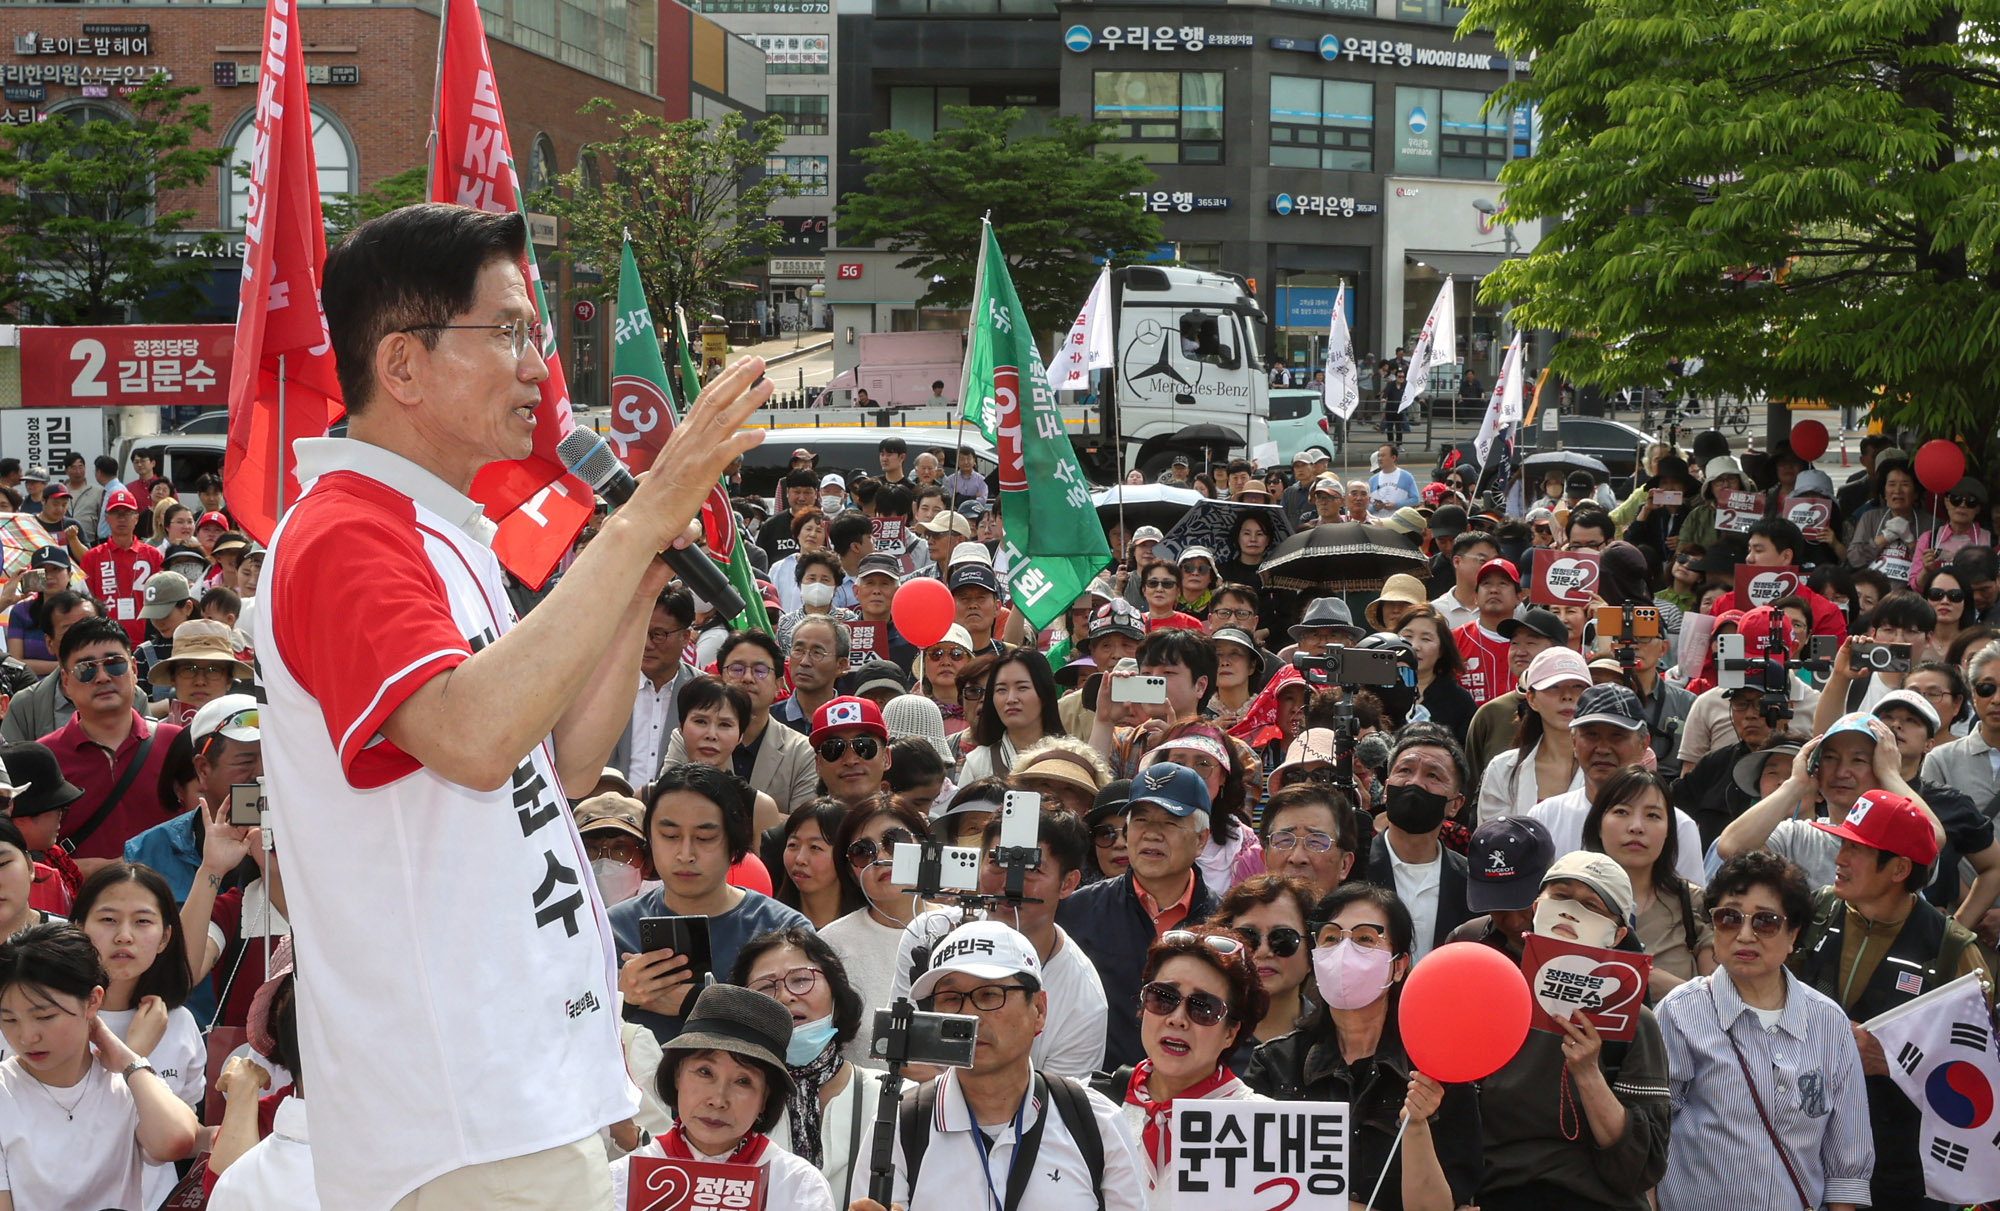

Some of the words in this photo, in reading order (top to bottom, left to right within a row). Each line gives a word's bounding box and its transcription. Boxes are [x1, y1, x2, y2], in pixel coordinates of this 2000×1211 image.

[40, 36, 148, 56] 로이드밤헤어
[1099, 26, 1204, 51] 우리은행
[1208, 34, 1253, 46] 운정중앙지점
[1342, 37, 1413, 67] 우리은행
[1416, 48, 1456, 67] WOORI
[1456, 53, 1492, 70] BANK
[29, 88, 42, 98] 4F
[1197, 197, 1227, 207] 365코너
[1295, 195, 1355, 218] 우리은행
[176, 241, 245, 258] PARIS
[775, 261, 821, 271] DESSERT
[842, 265, 858, 277] 5G
[578, 305, 590, 319] 약
[133, 339, 199, 358] 정정당당
[69, 338, 108, 397] 2
[118, 359, 217, 393] 김문수
[1150, 377, 1249, 398] Mercedes-Benz
[27, 417, 42, 468] 정정당
[46, 417, 72, 484] 김문
[117, 492, 125, 501] 2
[883, 520, 901, 530] 정정
[1719, 508, 1737, 529] 2
[882, 530, 900, 539] 당당
[41, 546, 49, 559] J
[132, 560, 152, 591] 2
[1549, 575, 1580, 587] 김문수
[1551, 568, 1581, 576] 정정당당
[99, 560, 117, 612] 김문수
[146, 586, 157, 601] C
[1751, 588, 1781, 599] 김문수
[853, 626, 875, 638] 정정
[1460, 672, 1485, 687] 국민
[1485, 866, 1515, 874] PEUGEOT
[932, 937, 996, 970] 대한민국
[1546, 967, 1605, 990] 정정당당
[1539, 981, 1603, 1007] 김문수
[568, 990, 595, 1019] 국민의힘
[1178, 1110, 1346, 1196] 문수대통
[693, 1176, 755, 1205] 정정
